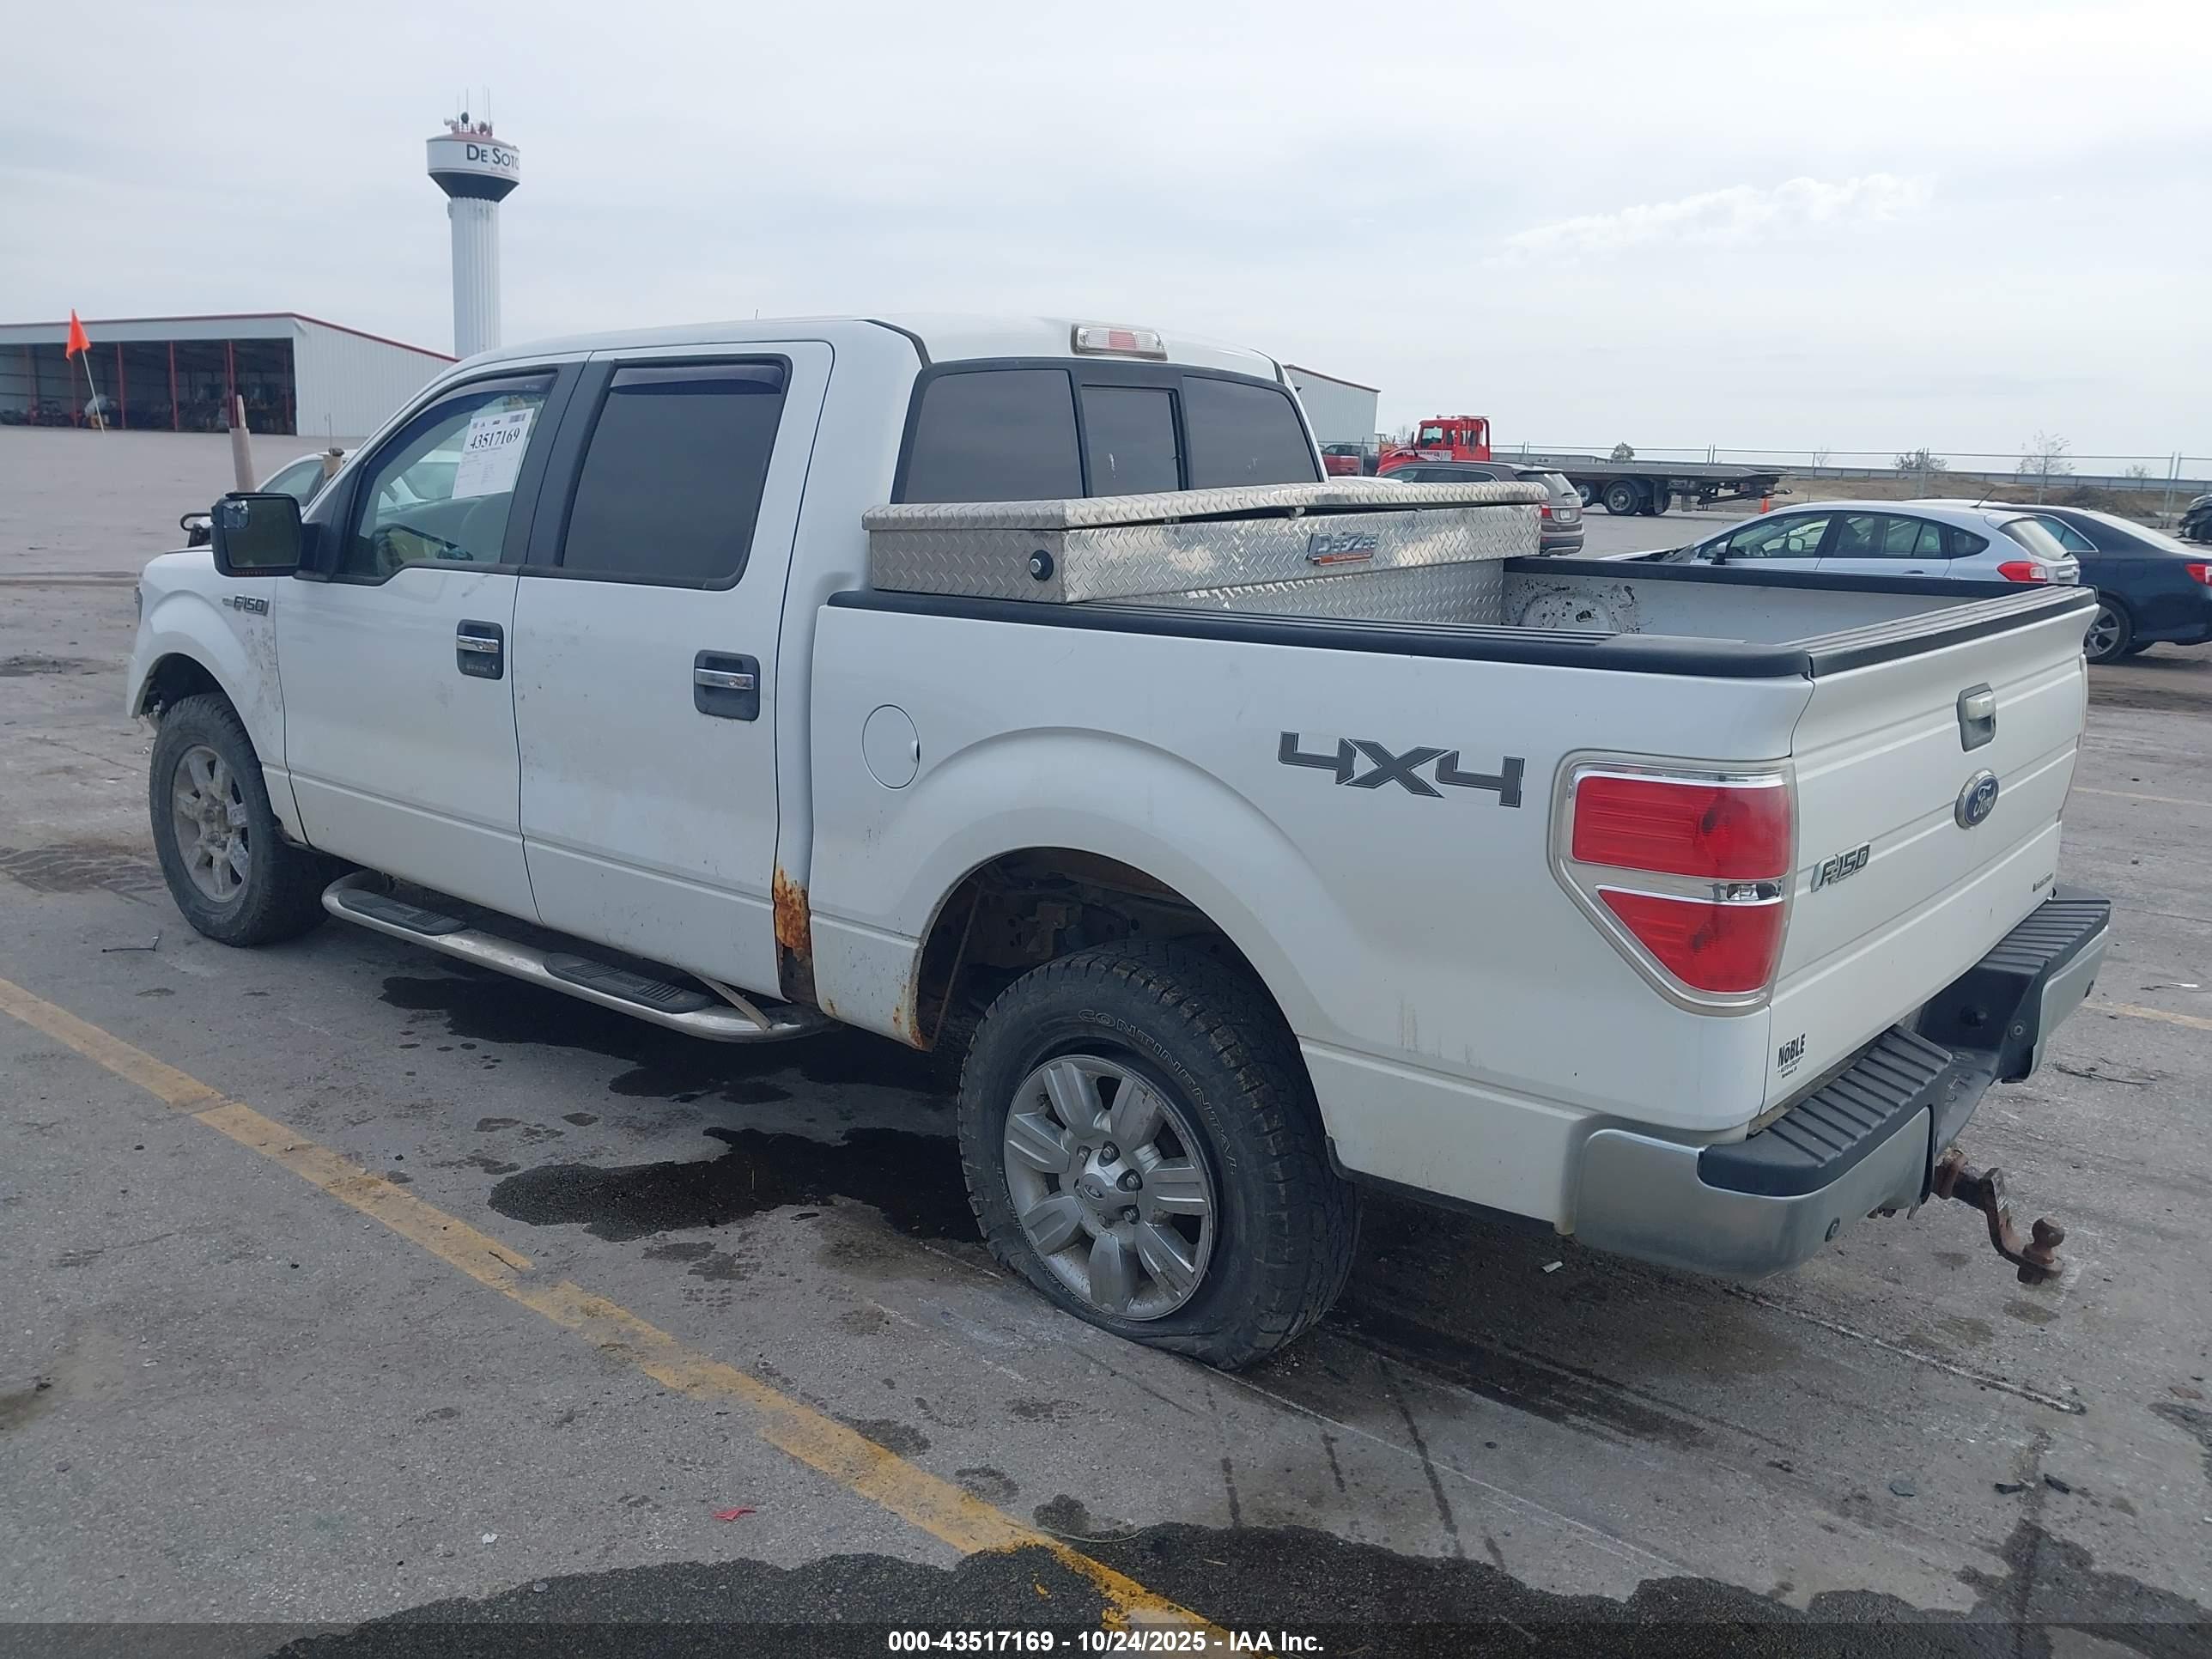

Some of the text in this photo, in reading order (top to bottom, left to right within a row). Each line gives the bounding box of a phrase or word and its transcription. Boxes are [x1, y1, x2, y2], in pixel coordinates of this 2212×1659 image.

[470, 428, 520, 449] 43517169
[1818, 844, 1870, 886] F-150
[1079, 1010, 1237, 1175] CONTINENTAL
